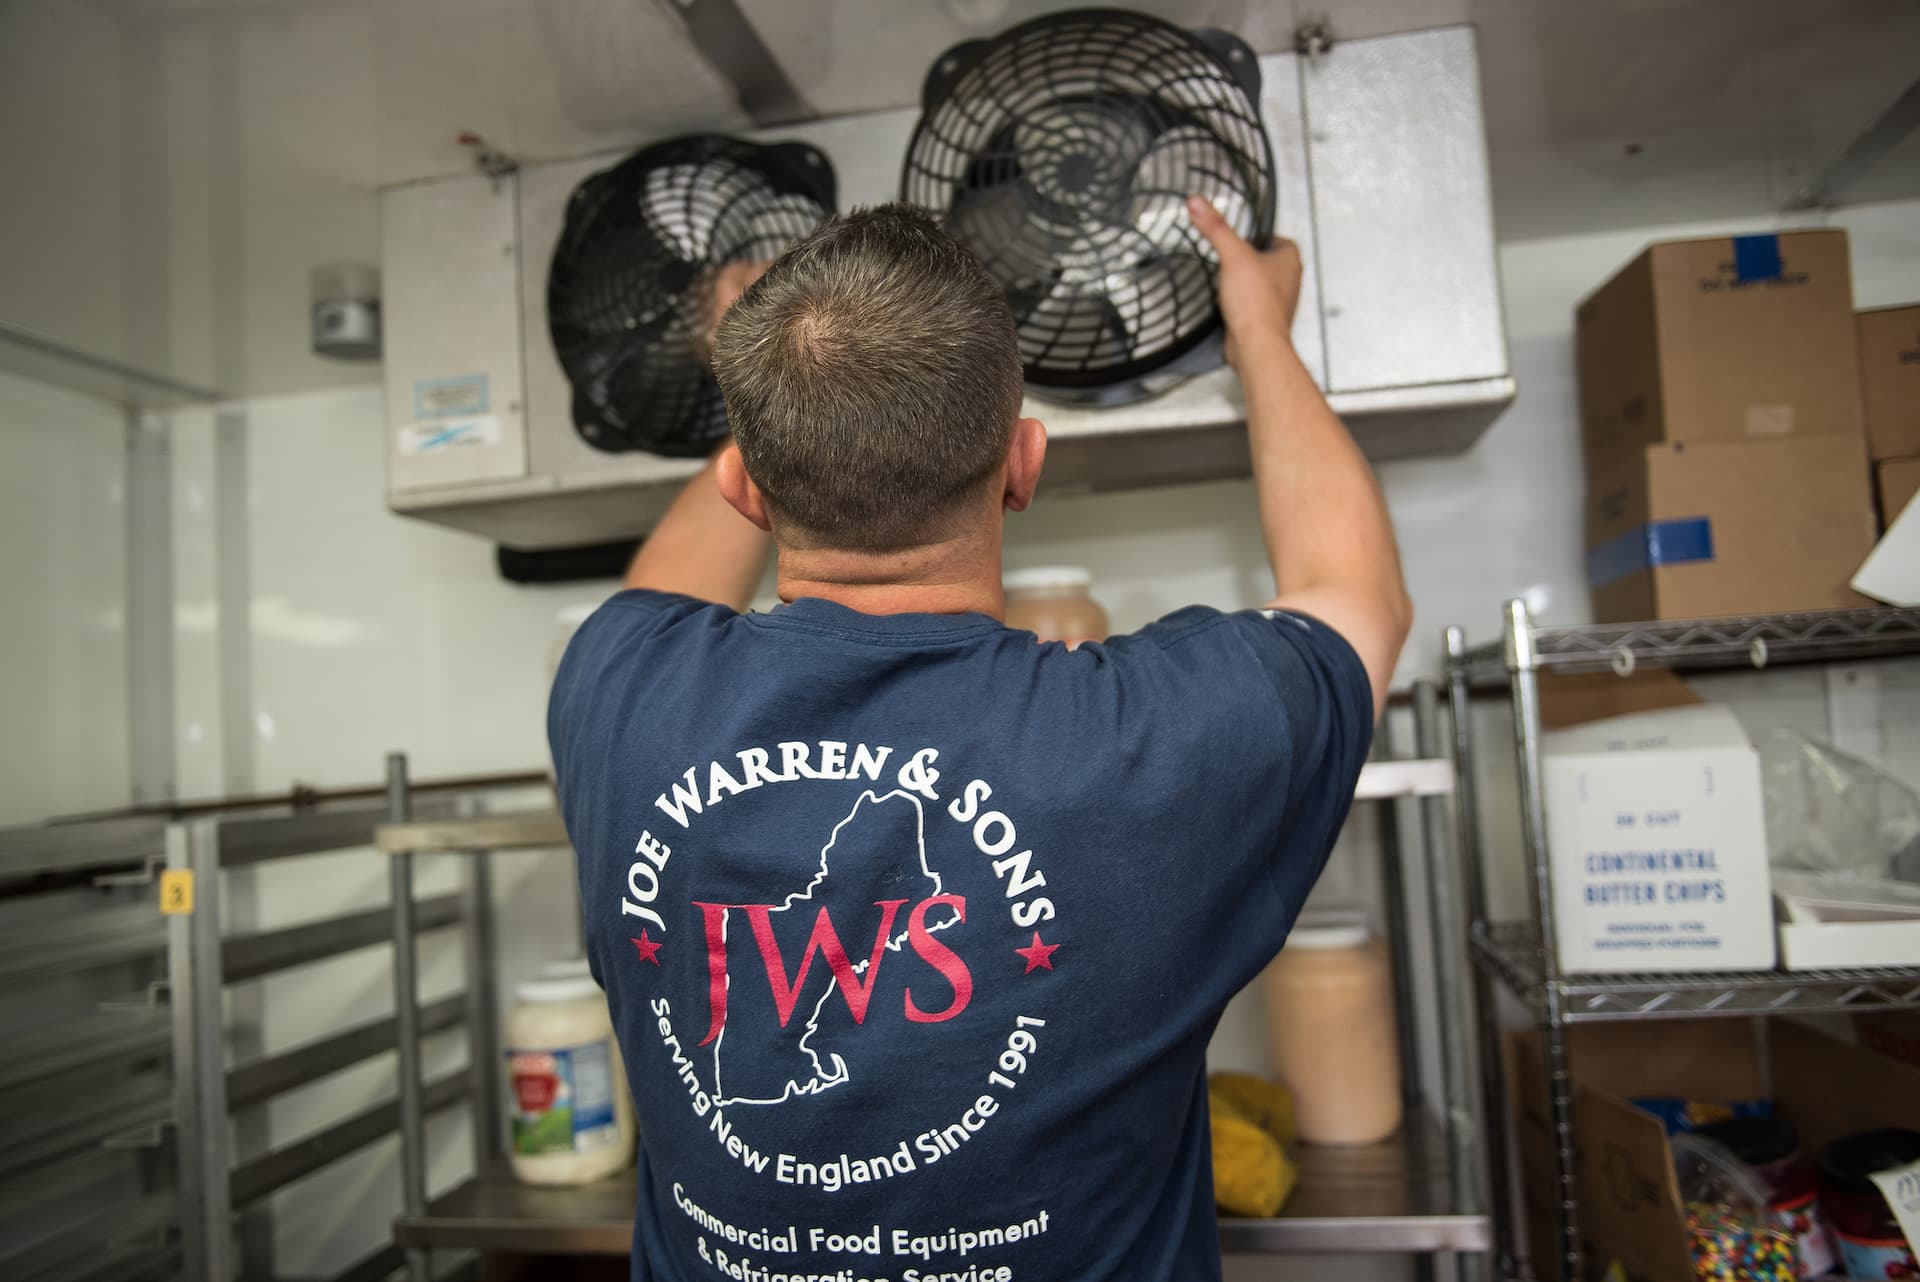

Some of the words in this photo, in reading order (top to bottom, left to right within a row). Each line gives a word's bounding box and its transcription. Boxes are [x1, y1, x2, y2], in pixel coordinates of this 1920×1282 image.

[621, 830, 672, 932] JOE
[655, 740, 894, 829] WARREN
[897, 747, 940, 801] &
[947, 778, 1056, 928] SONS
[1586, 850, 1717, 874] CONTINENTAL
[1586, 880, 1656, 905] BUTTER
[1666, 879, 1725, 903] CHIPS
[691, 894, 973, 1047] JWS
[650, 997, 712, 1117] Serving
[709, 1108, 771, 1174] New
[776, 1141, 917, 1192] England
[919, 1094, 1000, 1165] Since
[988, 1015, 1047, 1090] 1991
[673, 1182, 798, 1254] Commercial
[809, 1224, 881, 1255] Food
[892, 1209, 1050, 1263] Equipment
[697, 1236, 714, 1265] &
[715, 1248, 891, 1282] Refrierati
[902, 1264, 1013, 1282] Service
